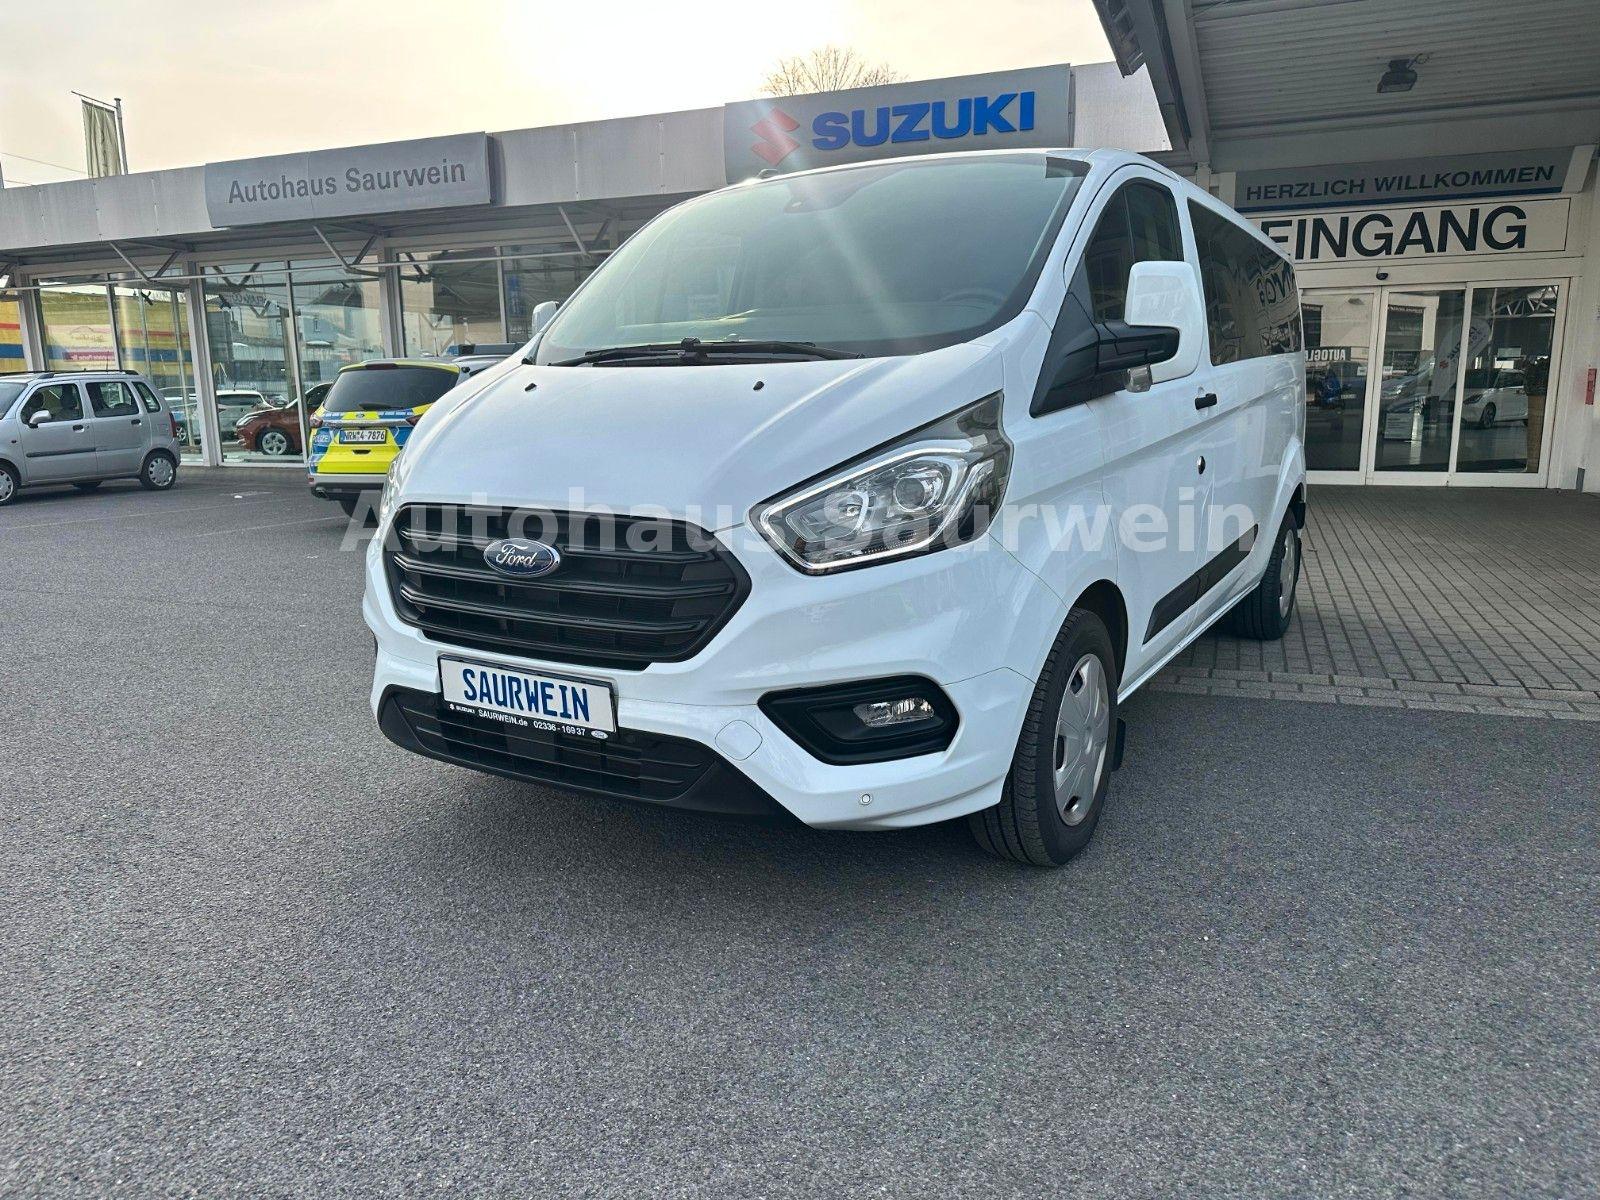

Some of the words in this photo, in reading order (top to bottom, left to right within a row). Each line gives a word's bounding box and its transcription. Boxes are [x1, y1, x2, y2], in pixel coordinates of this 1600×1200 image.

[811, 91, 1035, 151] SUZUKI
[228, 175, 337, 204] Autohaus
[345, 158, 466, 193] Saurwein
[1246, 178, 1365, 200] HERZLICH
[1374, 165, 1554, 192] WILLKOMMEN
[1260, 205, 1527, 260] EINGANG
[495, 543, 537, 567] Ford
[462, 668, 590, 722] SAURWEIN
[478, 709, 528, 727] SAURWEIN.de
